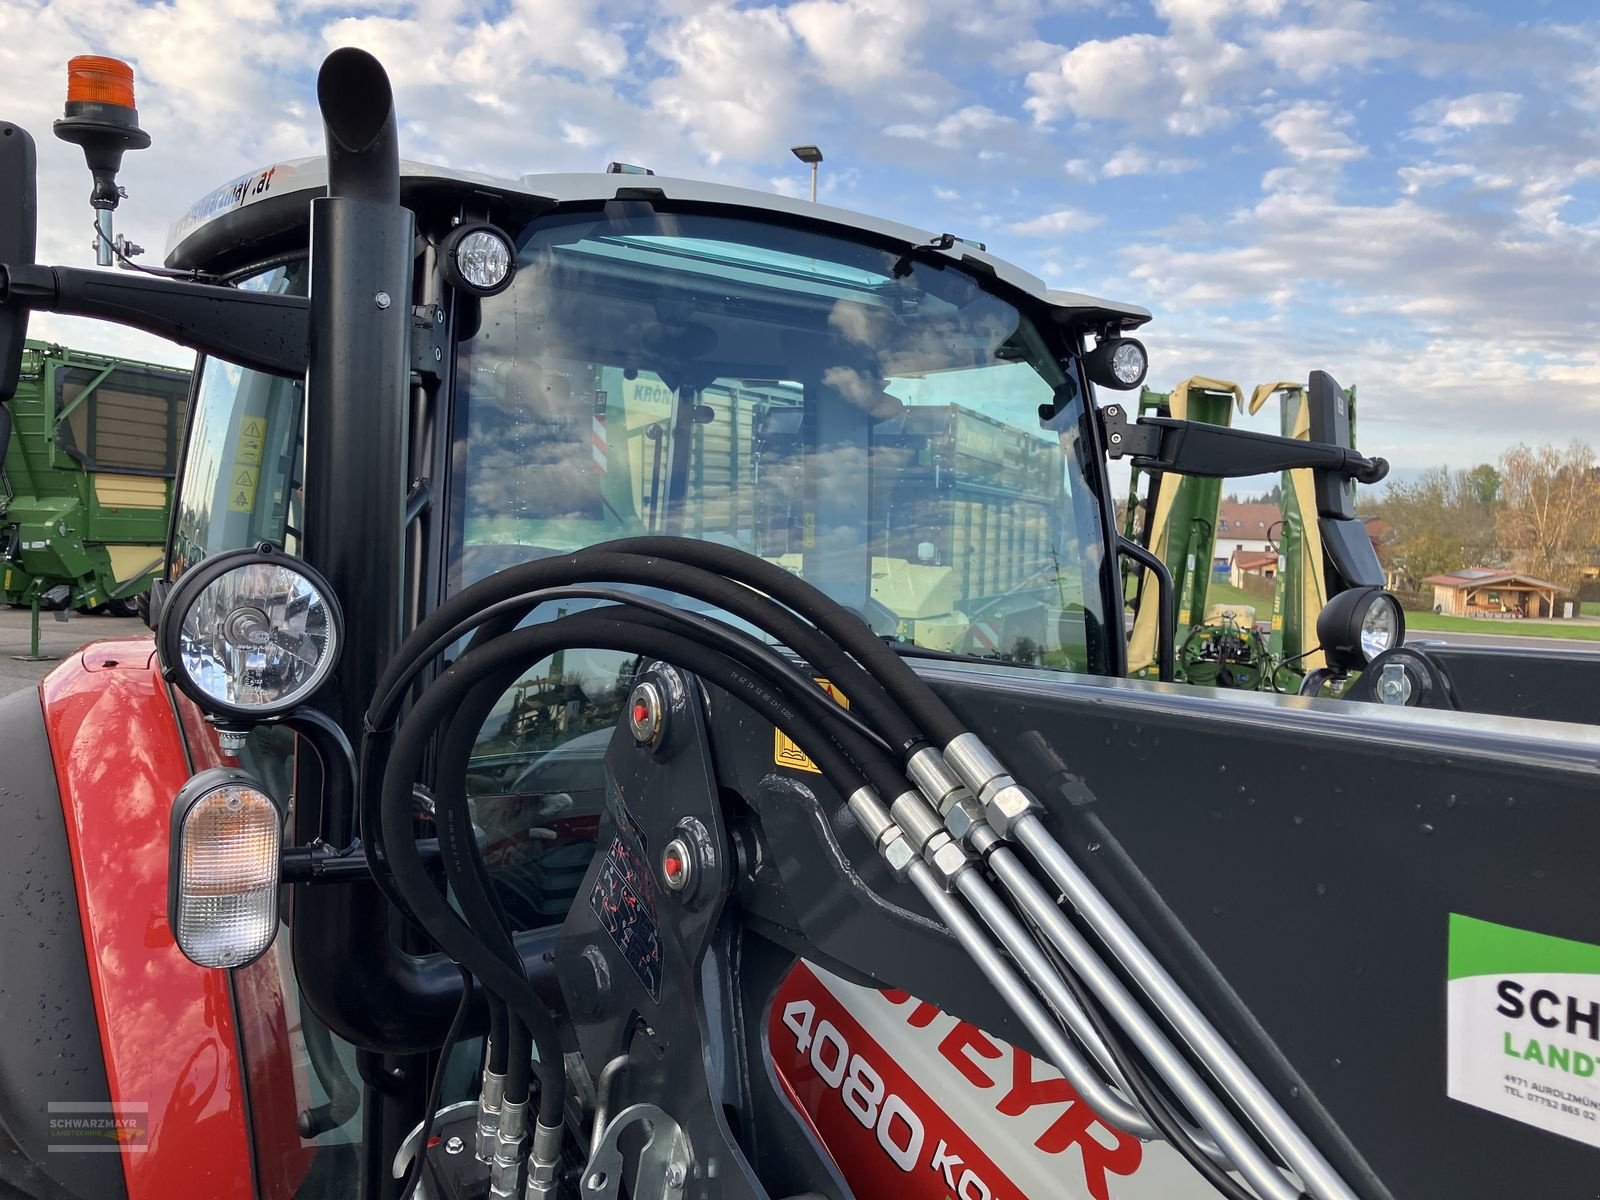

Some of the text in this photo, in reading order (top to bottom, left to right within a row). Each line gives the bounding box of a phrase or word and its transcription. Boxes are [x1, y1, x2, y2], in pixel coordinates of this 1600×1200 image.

[782, 999, 1000, 1200] 4080 KO
[1527, 1093, 1559, 1110] 07752
[1583, 1110, 1596, 1122] 02
